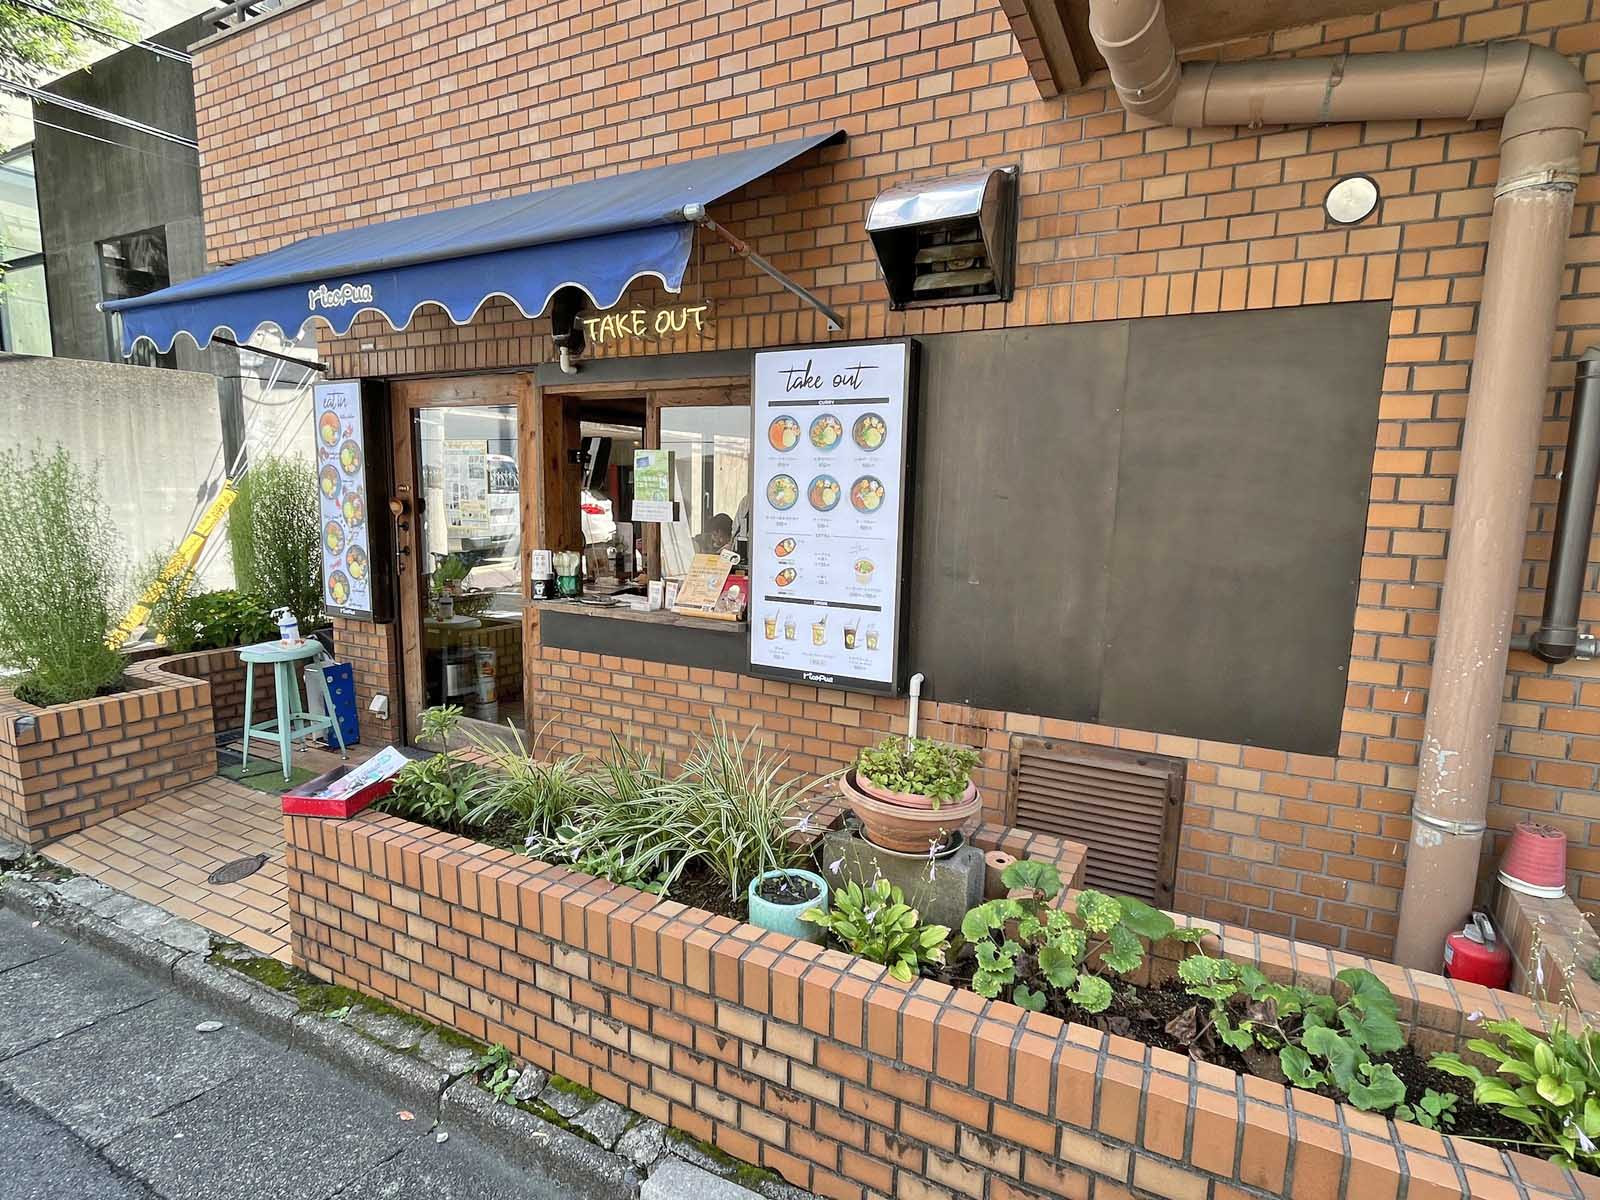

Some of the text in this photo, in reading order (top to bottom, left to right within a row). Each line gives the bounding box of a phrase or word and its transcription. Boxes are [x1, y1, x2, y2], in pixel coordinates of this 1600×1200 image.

[583, 306, 707, 343] TAKE OUT
[778, 359, 879, 392] take out
